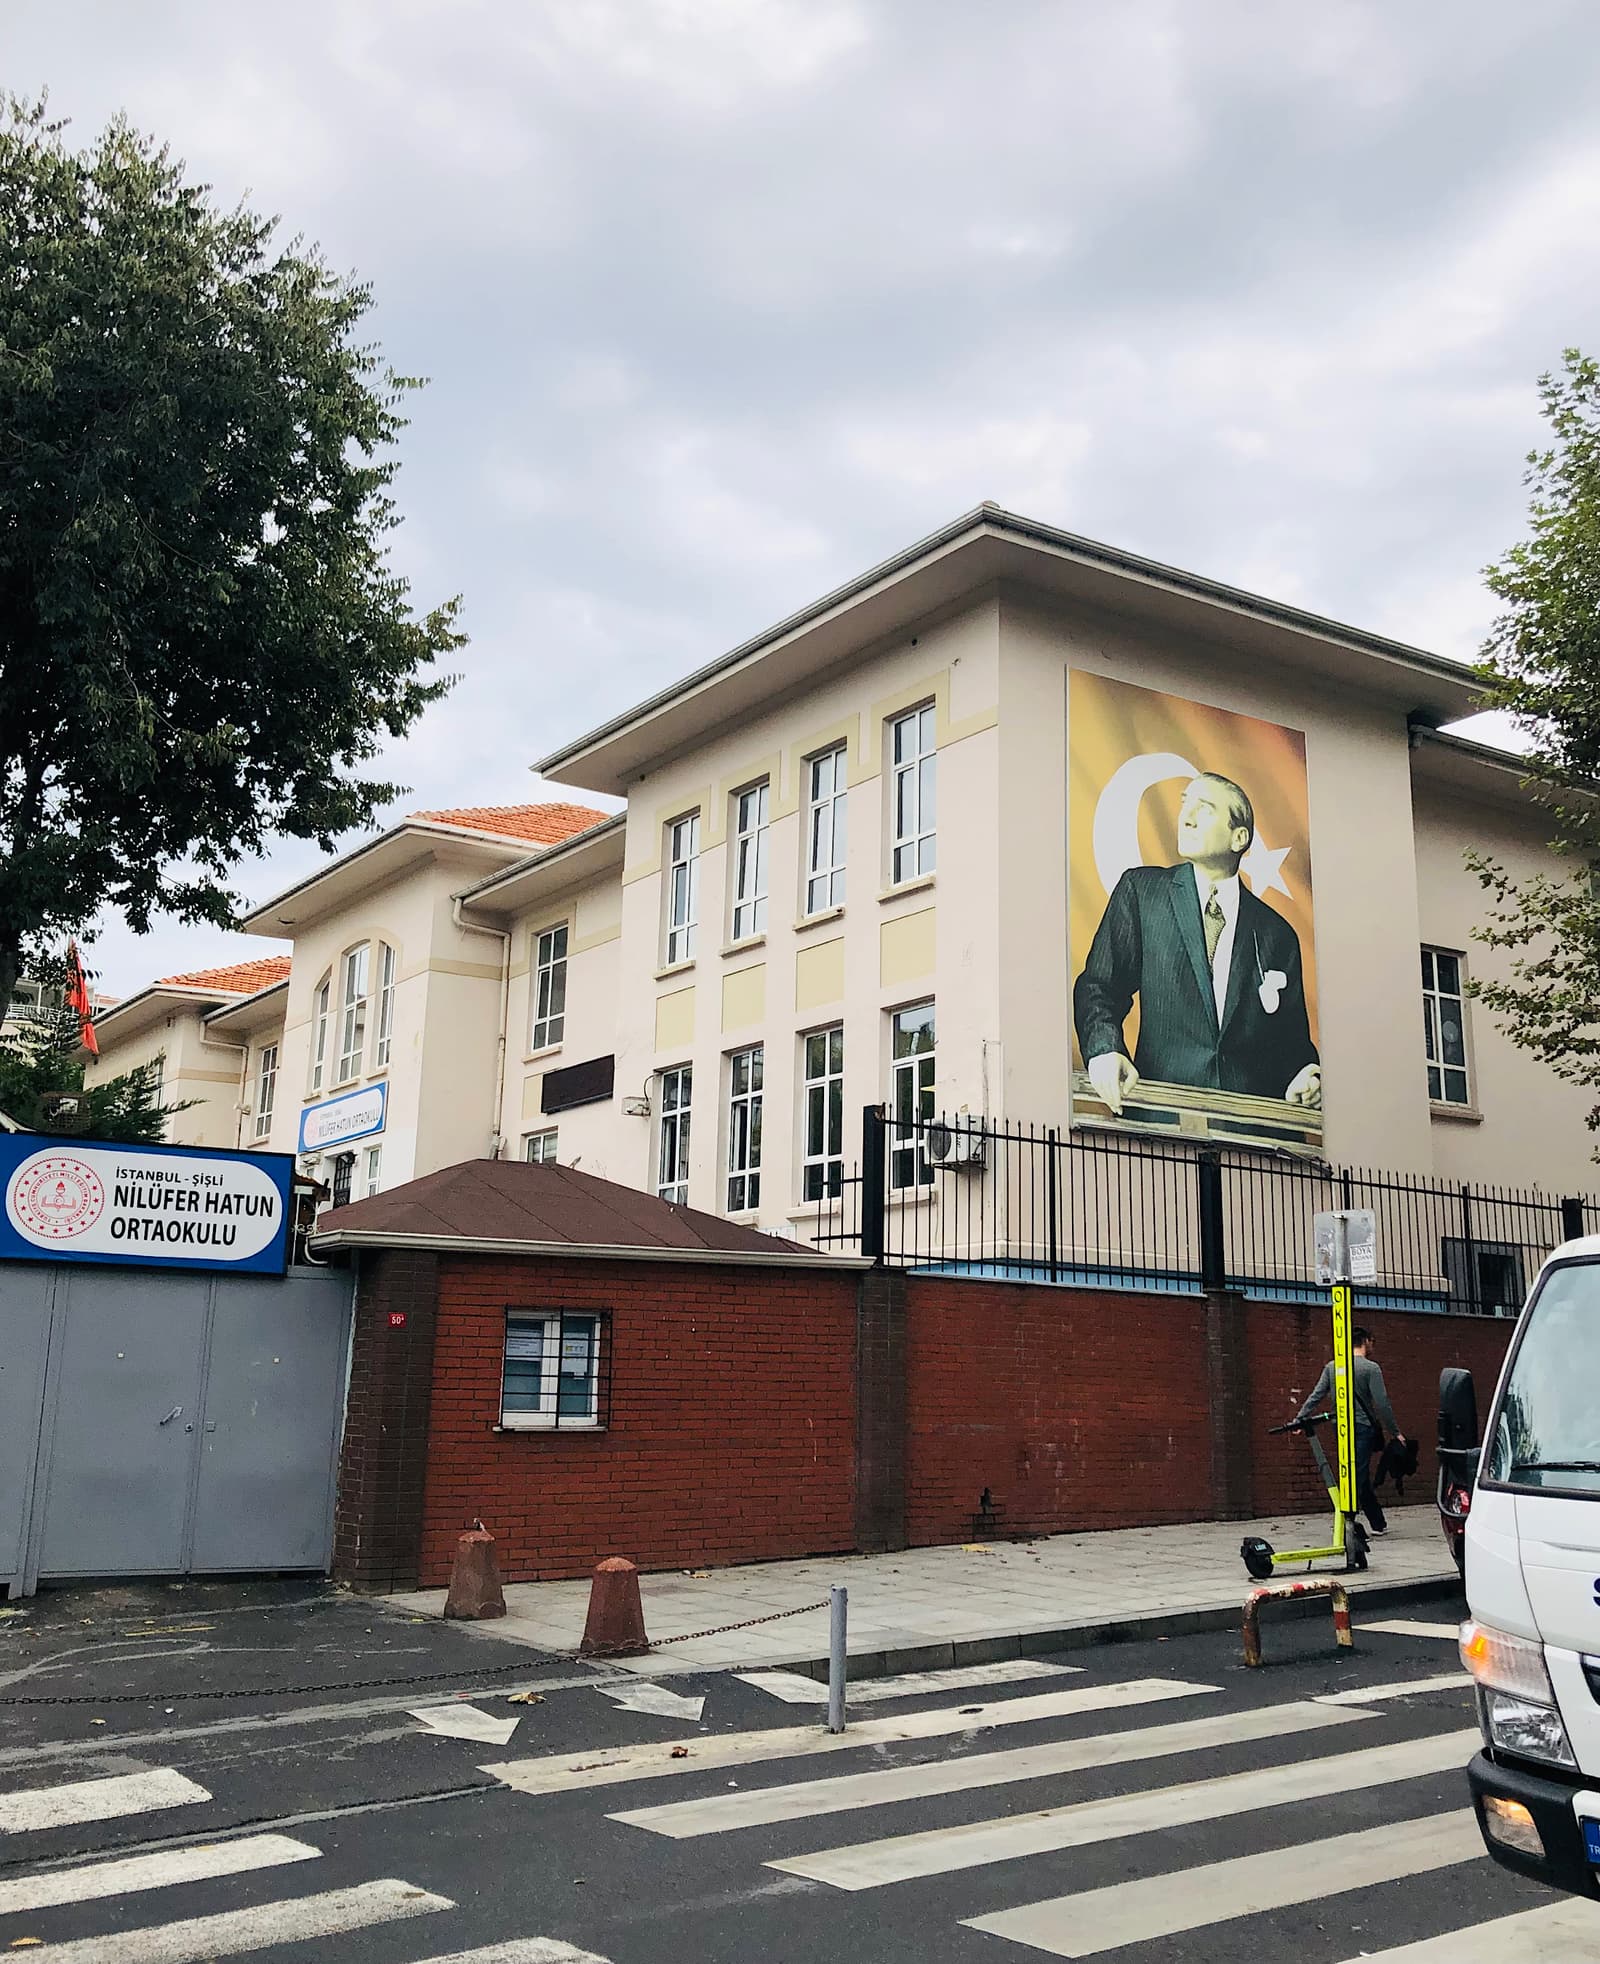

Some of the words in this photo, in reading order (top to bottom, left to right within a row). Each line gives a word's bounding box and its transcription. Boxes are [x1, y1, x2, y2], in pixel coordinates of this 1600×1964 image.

[116, 1166, 181, 1183] İSTANBUL
[192, 1173, 224, 1188] ŞİŞLİ
[113, 1182, 200, 1212] NİLÜFER
[205, 1191, 274, 1217] HATUN
[110, 1217, 236, 1246] ORTAOKULU
[1334, 1290, 1343, 1356] OKUL
